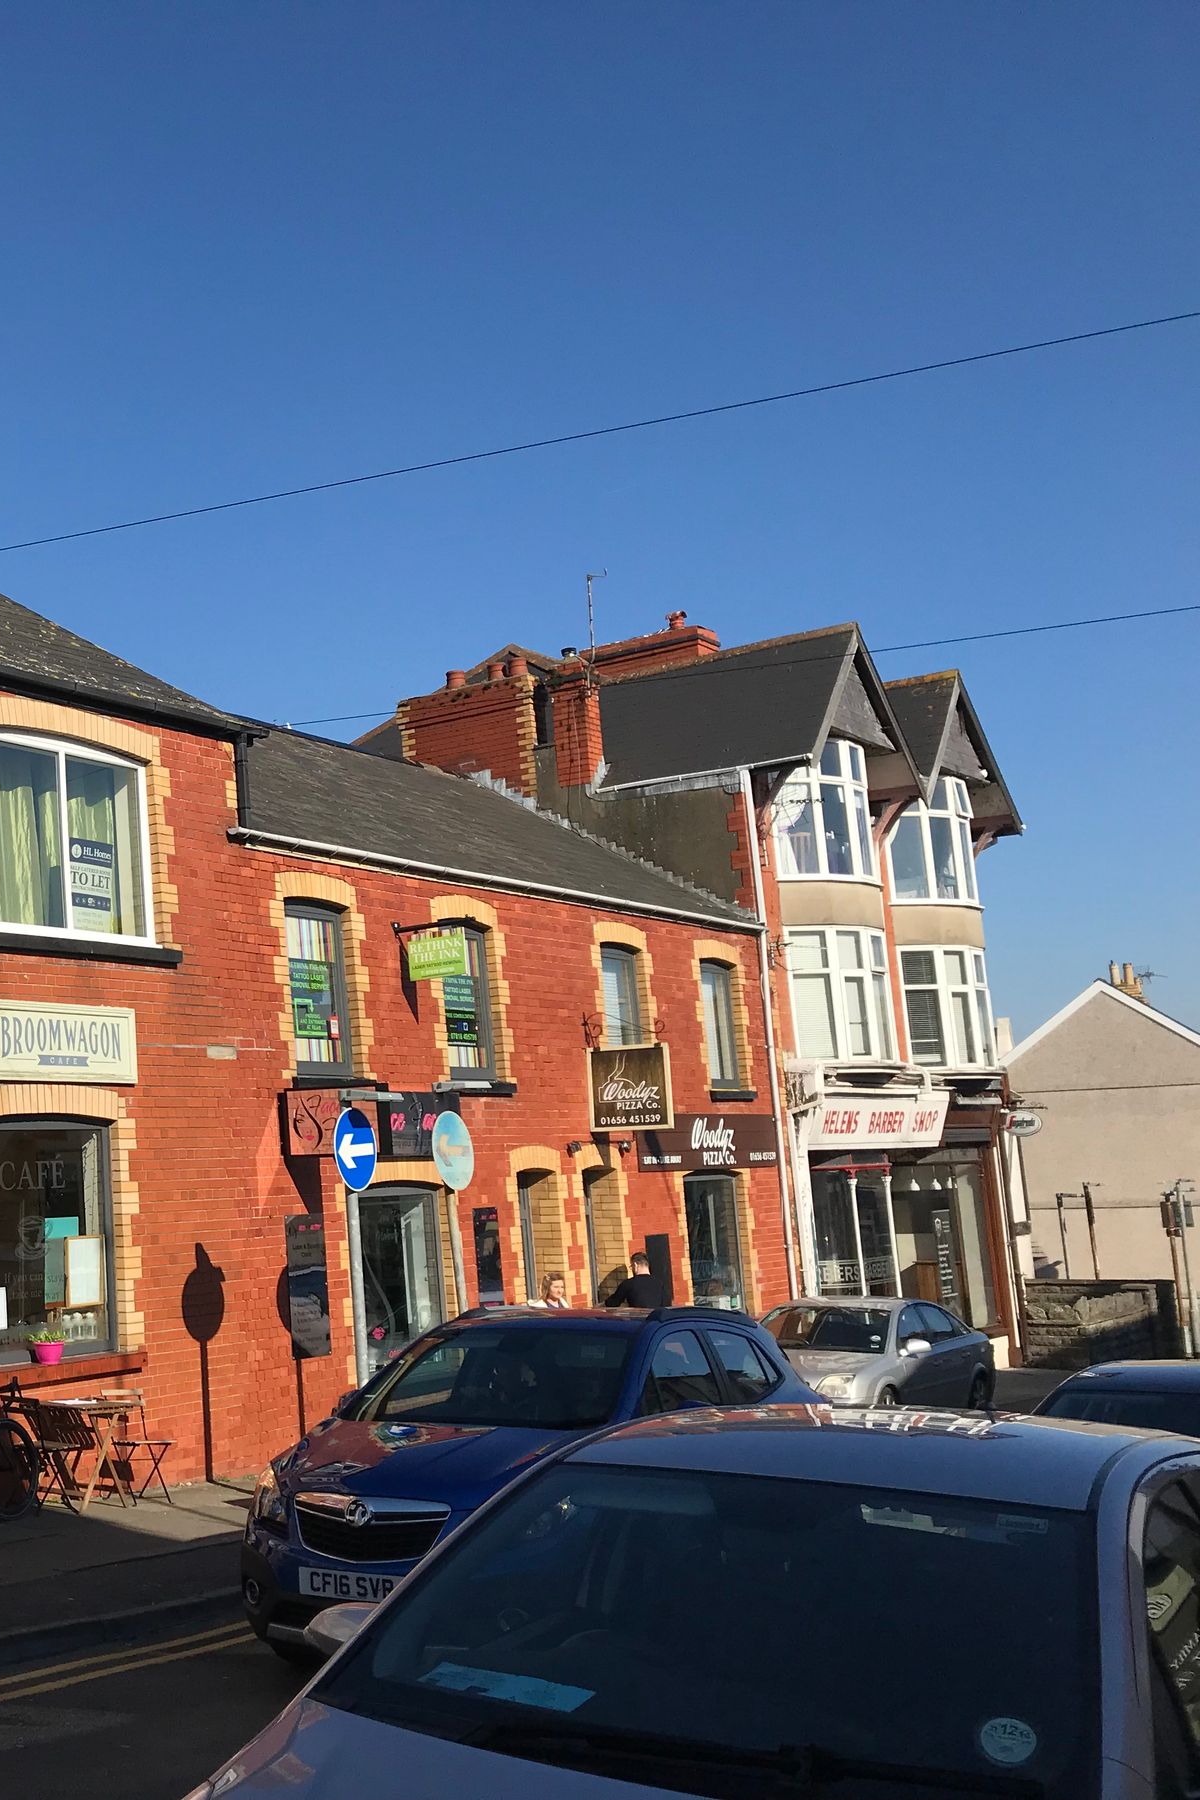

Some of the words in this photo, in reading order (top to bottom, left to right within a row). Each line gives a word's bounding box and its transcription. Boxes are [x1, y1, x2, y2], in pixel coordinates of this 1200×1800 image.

[83, 846, 93, 857] HL
[94, 848, 112, 860] Homes
[70, 870, 88, 886] TO
[91, 874, 110, 889] LET
[410, 937, 462, 954] RETHINK
[413, 951, 435, 963] THE
[439, 947, 461, 960] INK
[1, 1016, 122, 1061] BROOMWAGON
[603, 1080, 660, 1103] Woodyz
[617, 1100, 643, 1110] PIZZA
[646, 1100, 661, 1109] Co.
[600, 1116, 627, 1125] 01656
[629, 1114, 661, 1123] 451539
[821, 1110, 860, 1134] HELENS
[868, 1110, 905, 1134] BARBER
[912, 1109, 939, 1133] SHOP
[691, 1117, 736, 1156] Woodyz
[703, 1151, 723, 1166] PIZZA
[726, 1150, 737, 1165] Co.
[310, 1571, 351, 1596] CF16
